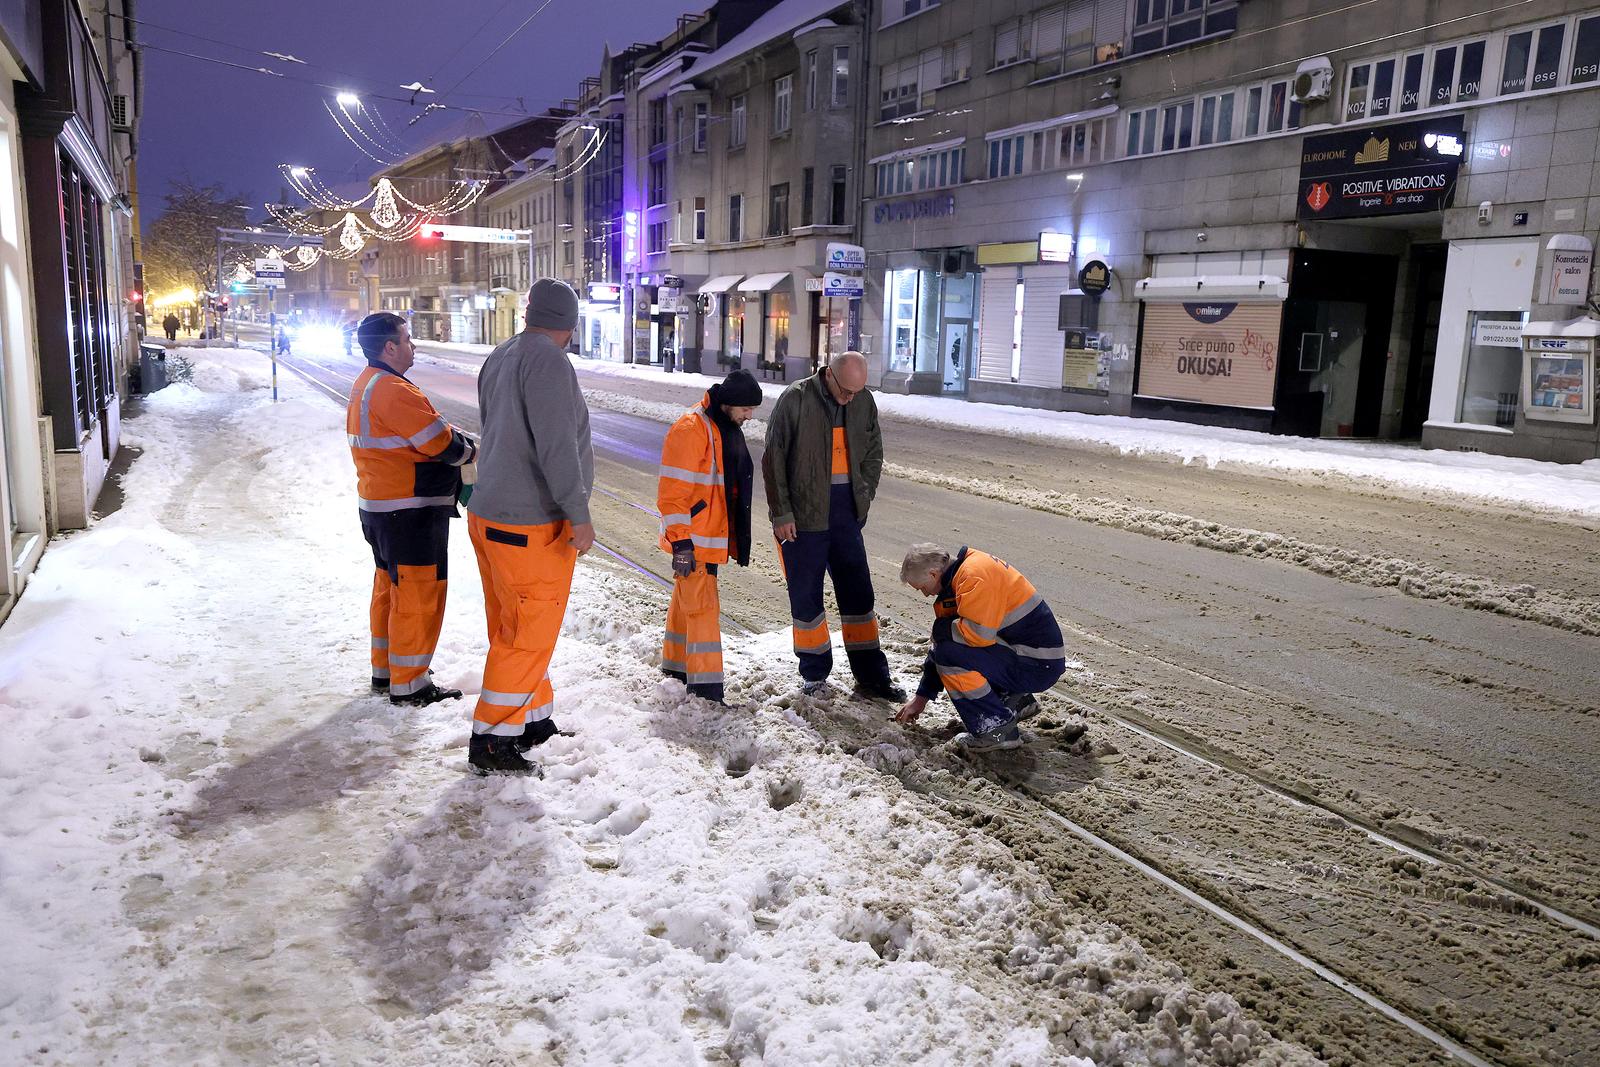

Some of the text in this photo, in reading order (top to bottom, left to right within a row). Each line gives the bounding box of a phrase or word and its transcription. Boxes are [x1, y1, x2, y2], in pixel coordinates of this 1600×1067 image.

[1303, 150, 1347, 163] EUROHOME
[1342, 174, 1446, 195] POSITIVE VIBRATIONS
[1407, 193, 1424, 205] shop
[1565, 267, 1581, 275] salon
[1178, 337, 1235, 355] Srce puno
[1177, 356, 1233, 377] OKUSA!
